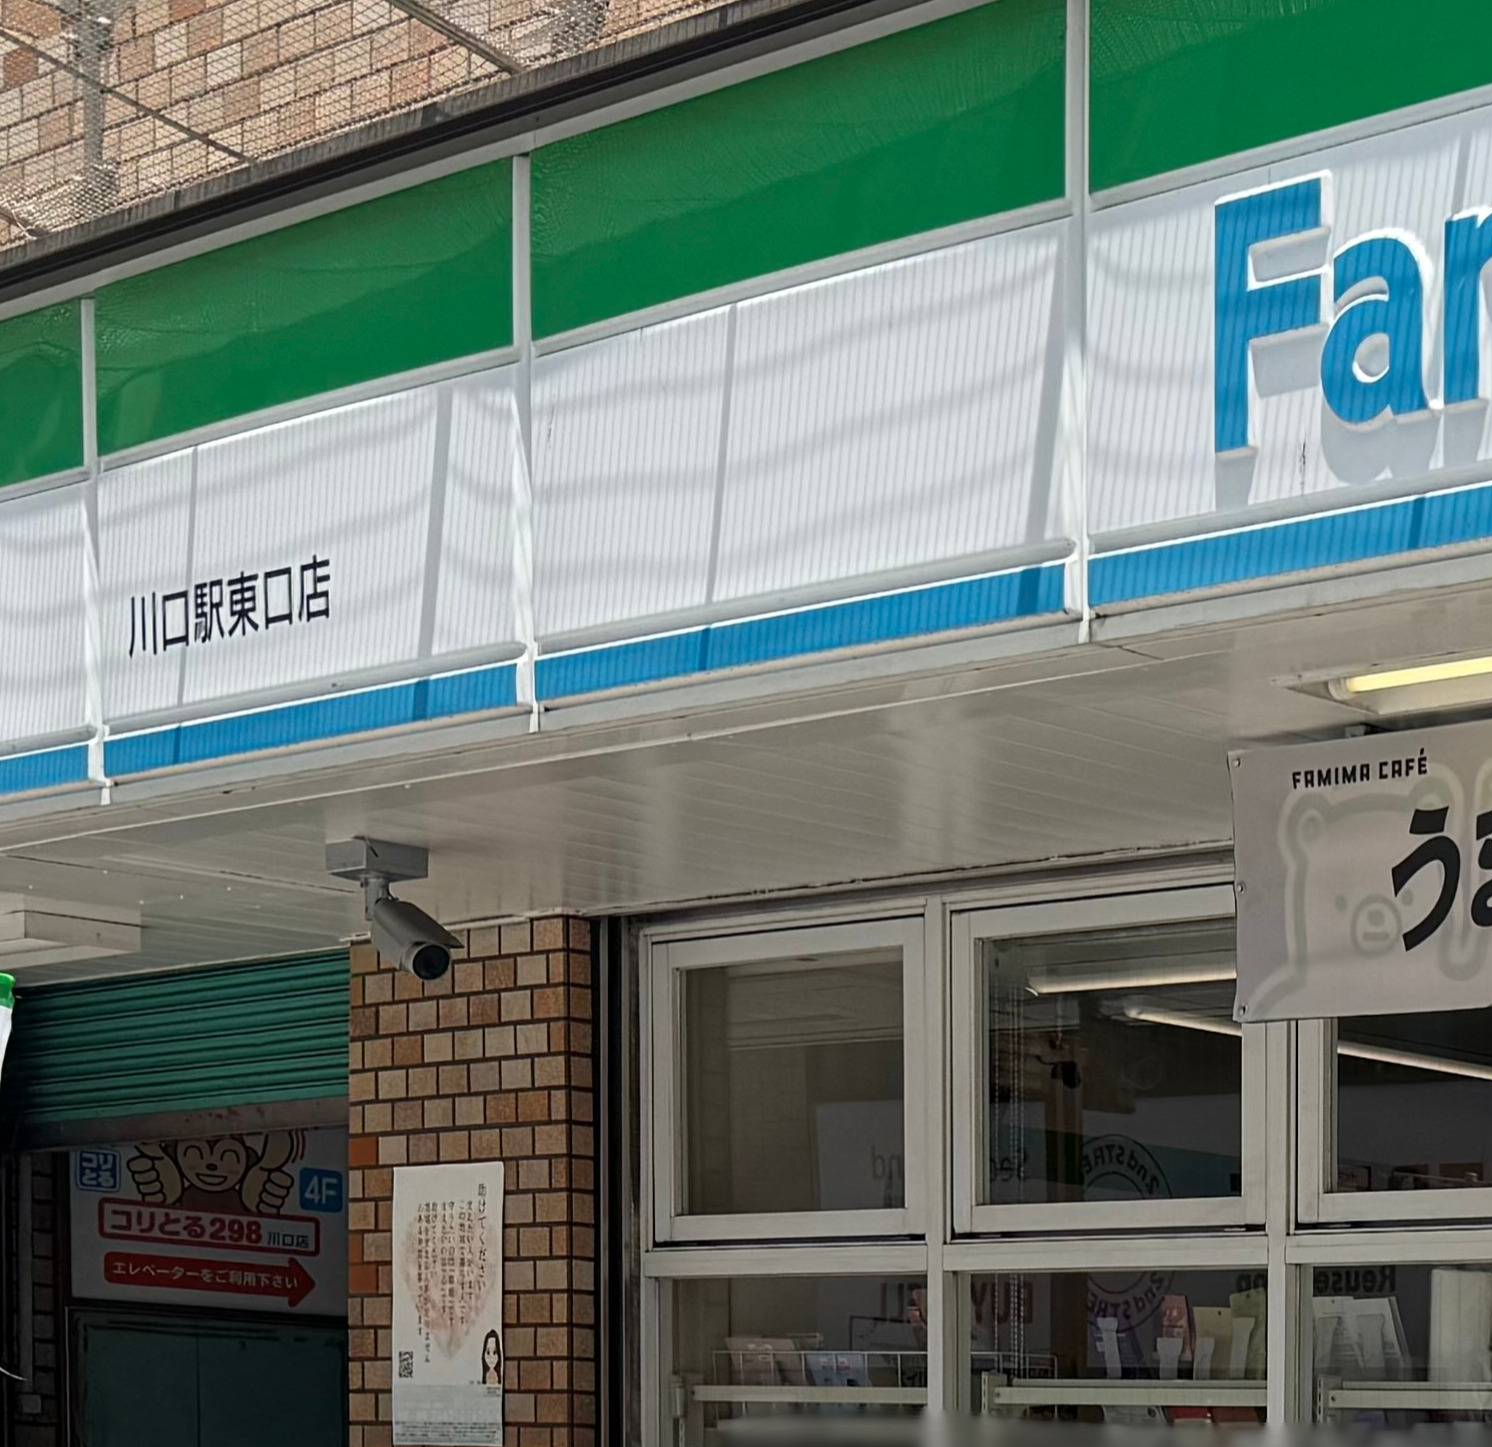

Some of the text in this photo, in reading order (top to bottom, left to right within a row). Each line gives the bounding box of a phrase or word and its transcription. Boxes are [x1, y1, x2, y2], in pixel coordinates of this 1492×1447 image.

[129, 554, 330, 658] 川口駅東口店
[1291, 747, 1428, 790] FAMIMA CAFÉ
[303, 1175, 339, 1204] 4F
[110, 1208, 309, 1249] コリとる298 川口店
[112, 1261, 299, 1289] エレベーターをご利用下さい
